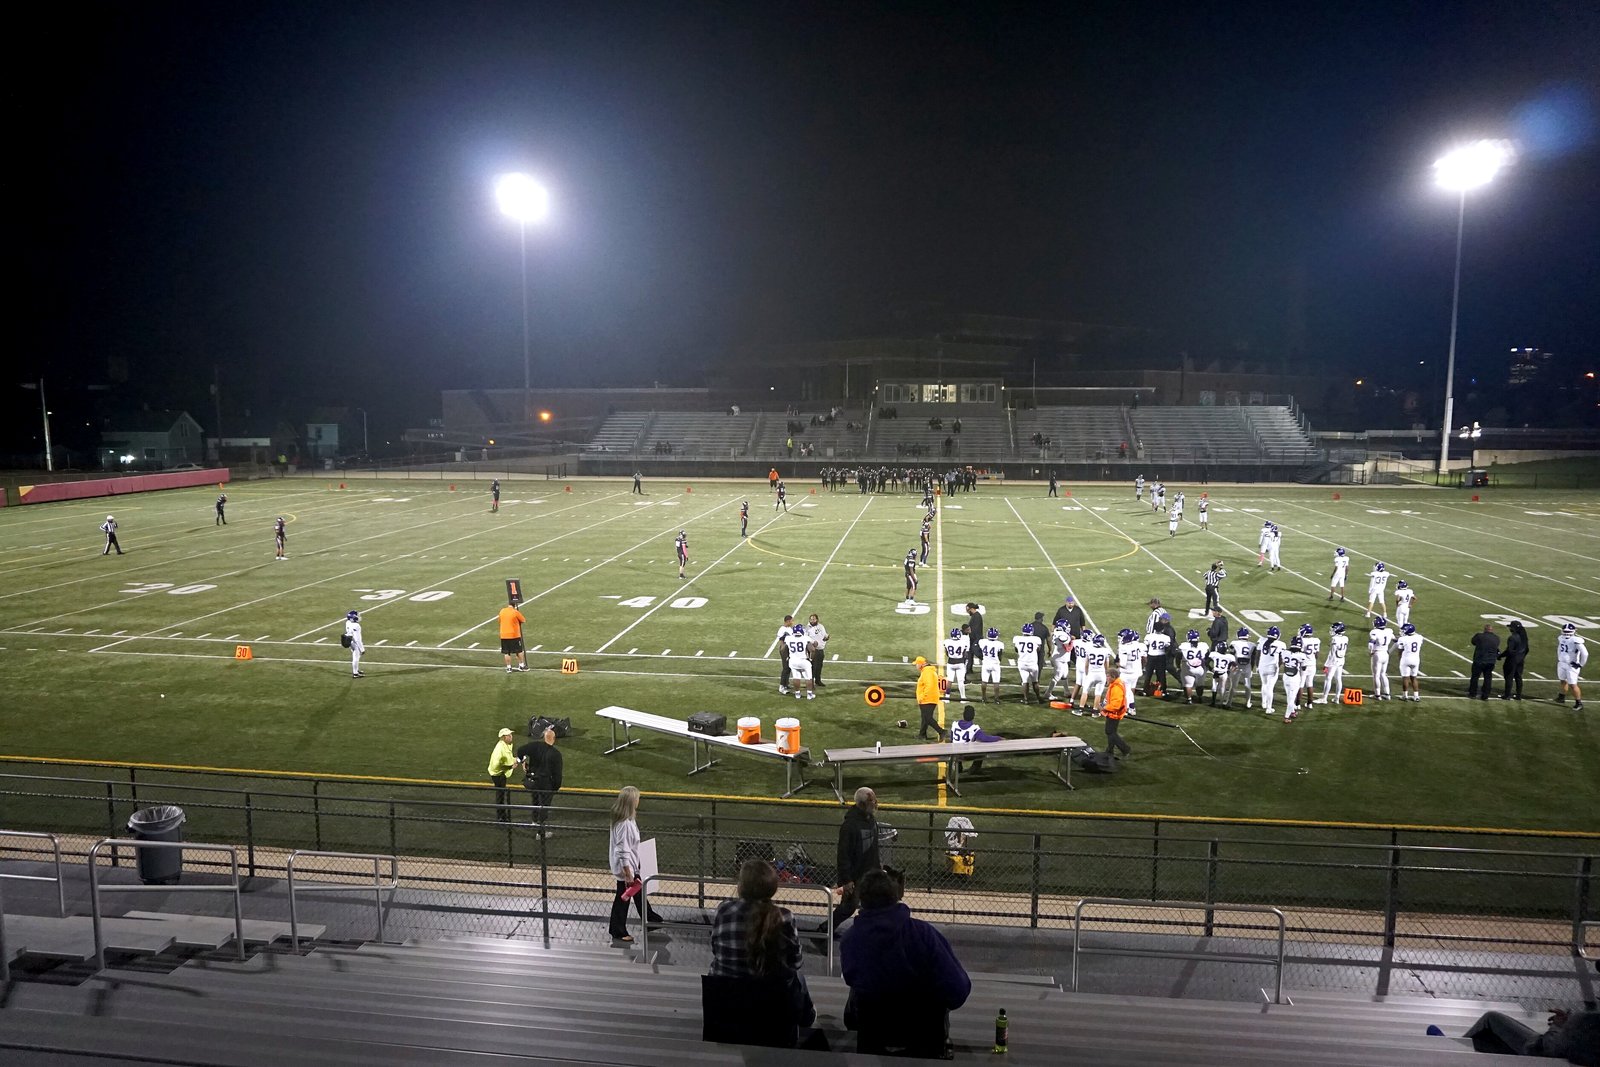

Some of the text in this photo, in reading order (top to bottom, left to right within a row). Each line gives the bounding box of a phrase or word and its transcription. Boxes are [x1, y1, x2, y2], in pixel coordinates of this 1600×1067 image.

[359, 588, 455, 602] 30
[616, 596, 709, 609] 40
[789, 641, 804, 653] 58
[947, 645, 962, 656] 84
[982, 645, 996, 658] 44
[1019, 641, 1034, 653] 79
[1151, 640, 1165, 651] 42
[1241, 646, 1250, 656] 6
[1411, 641, 1418, 652] 8
[1560, 643, 1569, 653] 51
[236, 646, 247, 658] 30
[1186, 650, 1202, 661] 64
[1089, 653, 1104, 666] 22
[1215, 658, 1229, 670] 13
[1283, 656, 1299, 668] 23
[562, 660, 575, 673] 40
[1346, 690, 1361, 703] 40
[953, 727, 971, 743] 54
